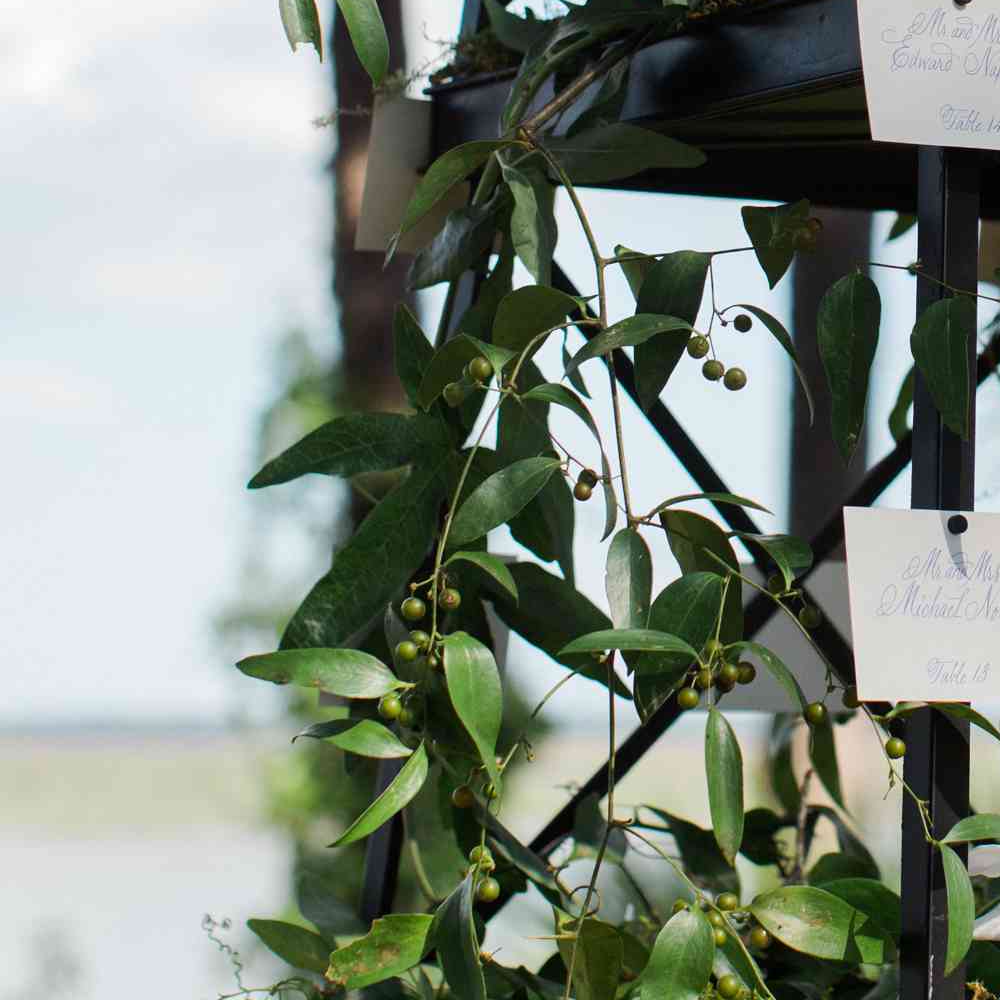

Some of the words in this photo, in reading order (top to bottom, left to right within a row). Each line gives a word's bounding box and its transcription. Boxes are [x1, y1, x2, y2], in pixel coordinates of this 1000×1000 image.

[951, 15, 974, 41] and
[881, 25, 957, 73] Edward
[938, 104, 984, 133] Table
[875, 581, 969, 619] Michael
[928, 657, 967, 685] Table
